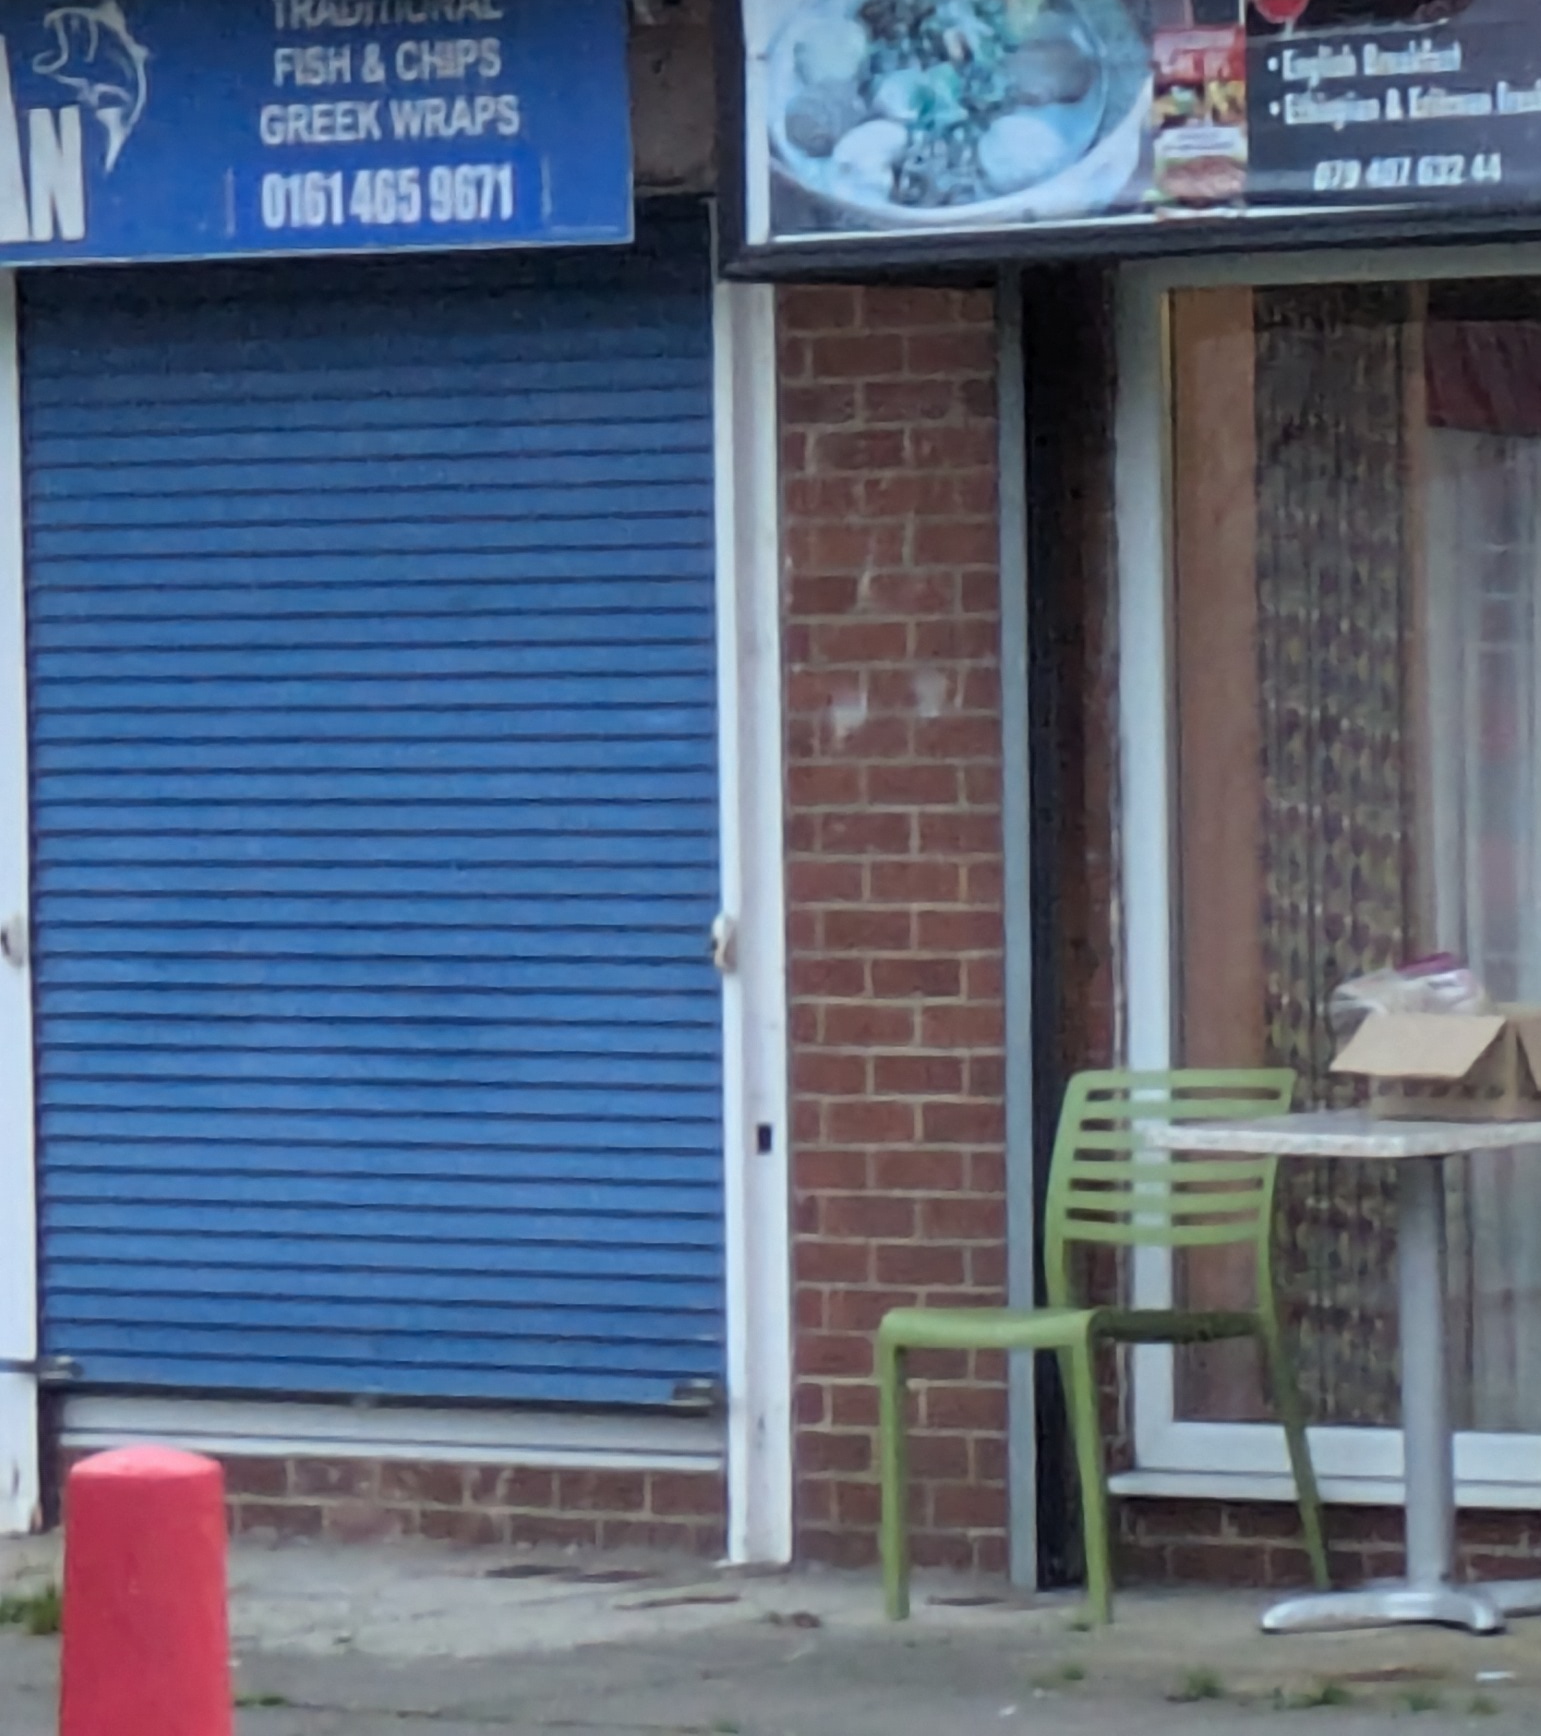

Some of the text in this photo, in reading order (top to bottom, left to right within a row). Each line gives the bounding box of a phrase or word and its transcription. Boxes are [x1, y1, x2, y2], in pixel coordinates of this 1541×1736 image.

[273, 37, 503, 87] FISH & CHIPS
[259, 94, 522, 147] GREEK WRAPS
[261, 161, 515, 229] 0161 465 9671
